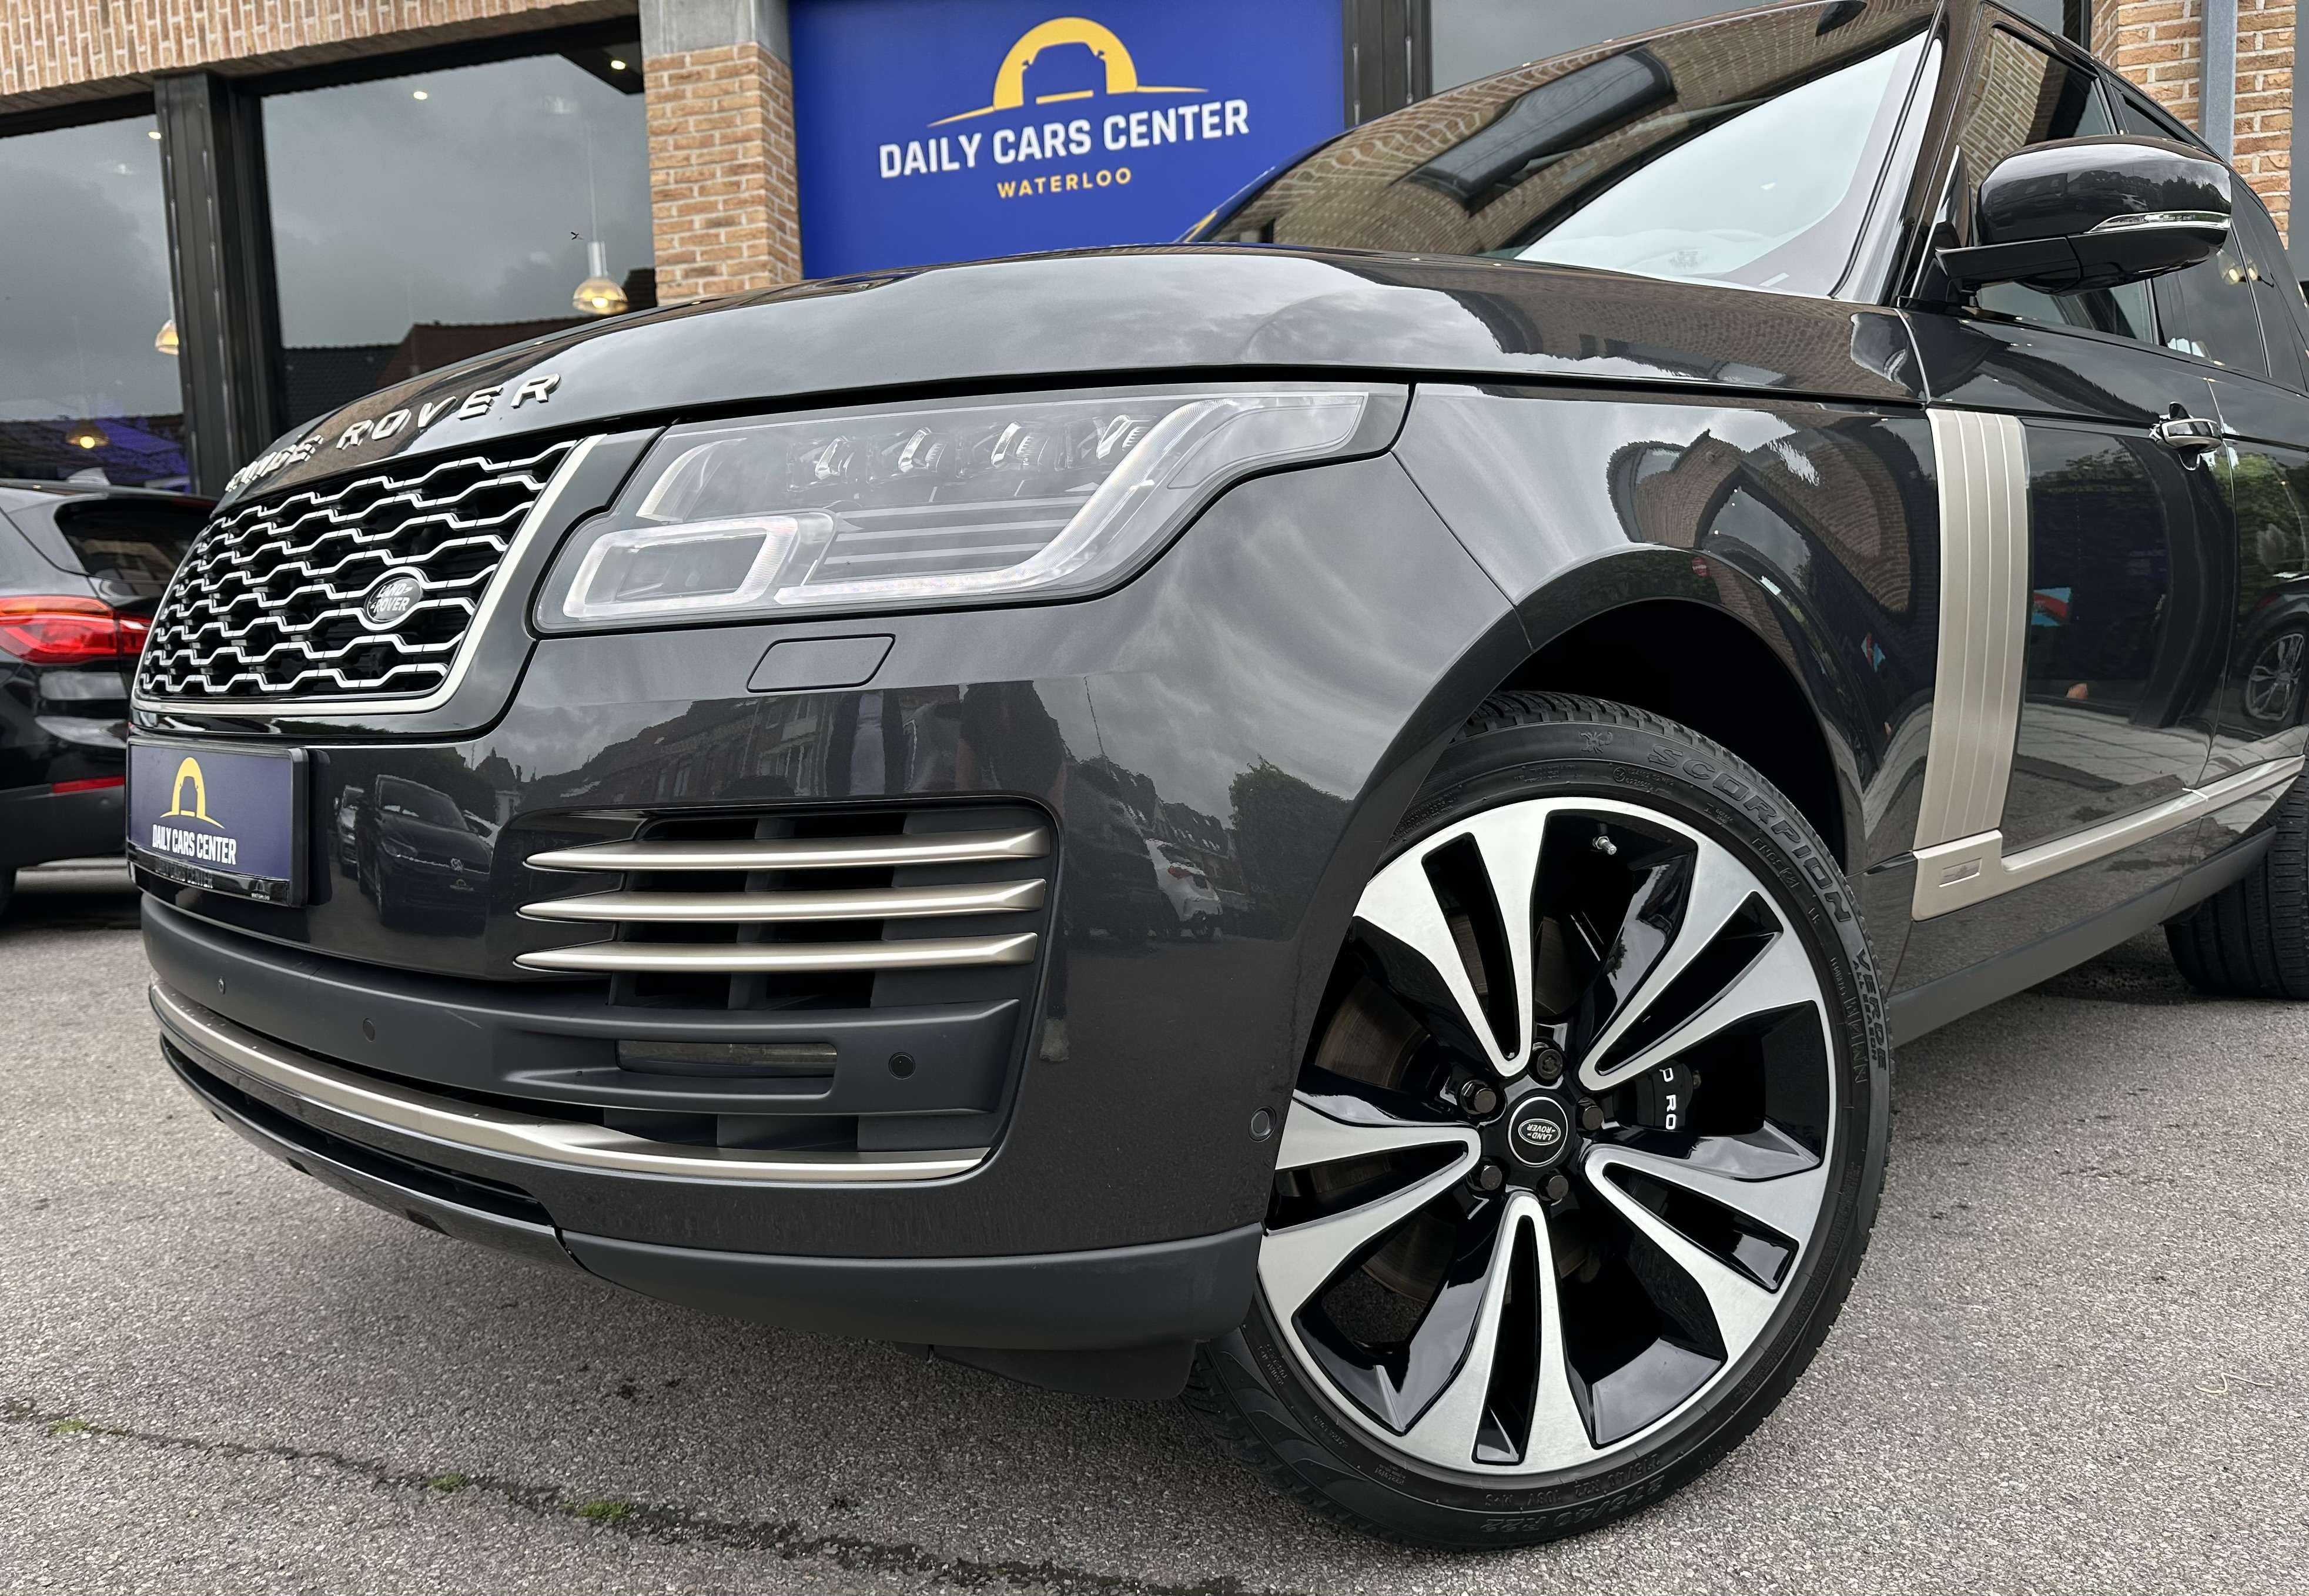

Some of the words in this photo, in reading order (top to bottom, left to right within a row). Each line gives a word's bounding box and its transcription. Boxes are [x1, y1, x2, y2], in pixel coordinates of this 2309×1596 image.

[879, 132, 982, 179] DAILY
[993, 119, 1092, 165] CARS
[1103, 99, 1250, 150] CENTER
[996, 167, 1132, 199] WATERLOO
[336, 373, 561, 450] ROVER
[373, 597, 410, 613] ROVER
[376, 583, 408, 598] LAND
[152, 824, 172, 851] DAILY
[172, 828, 196, 858] CARS
[196, 833, 237, 865] CENTER
[1647, 743, 1852, 922] SCORPION
[1852, 961, 1865, 989] ALL
[1862, 993, 1878, 1061] SEASON
[1856, 949, 1886, 1071] VERDE
[1527, 1123, 1552, 1134] ROVER
[1531, 1132, 1552, 1141] LAND
